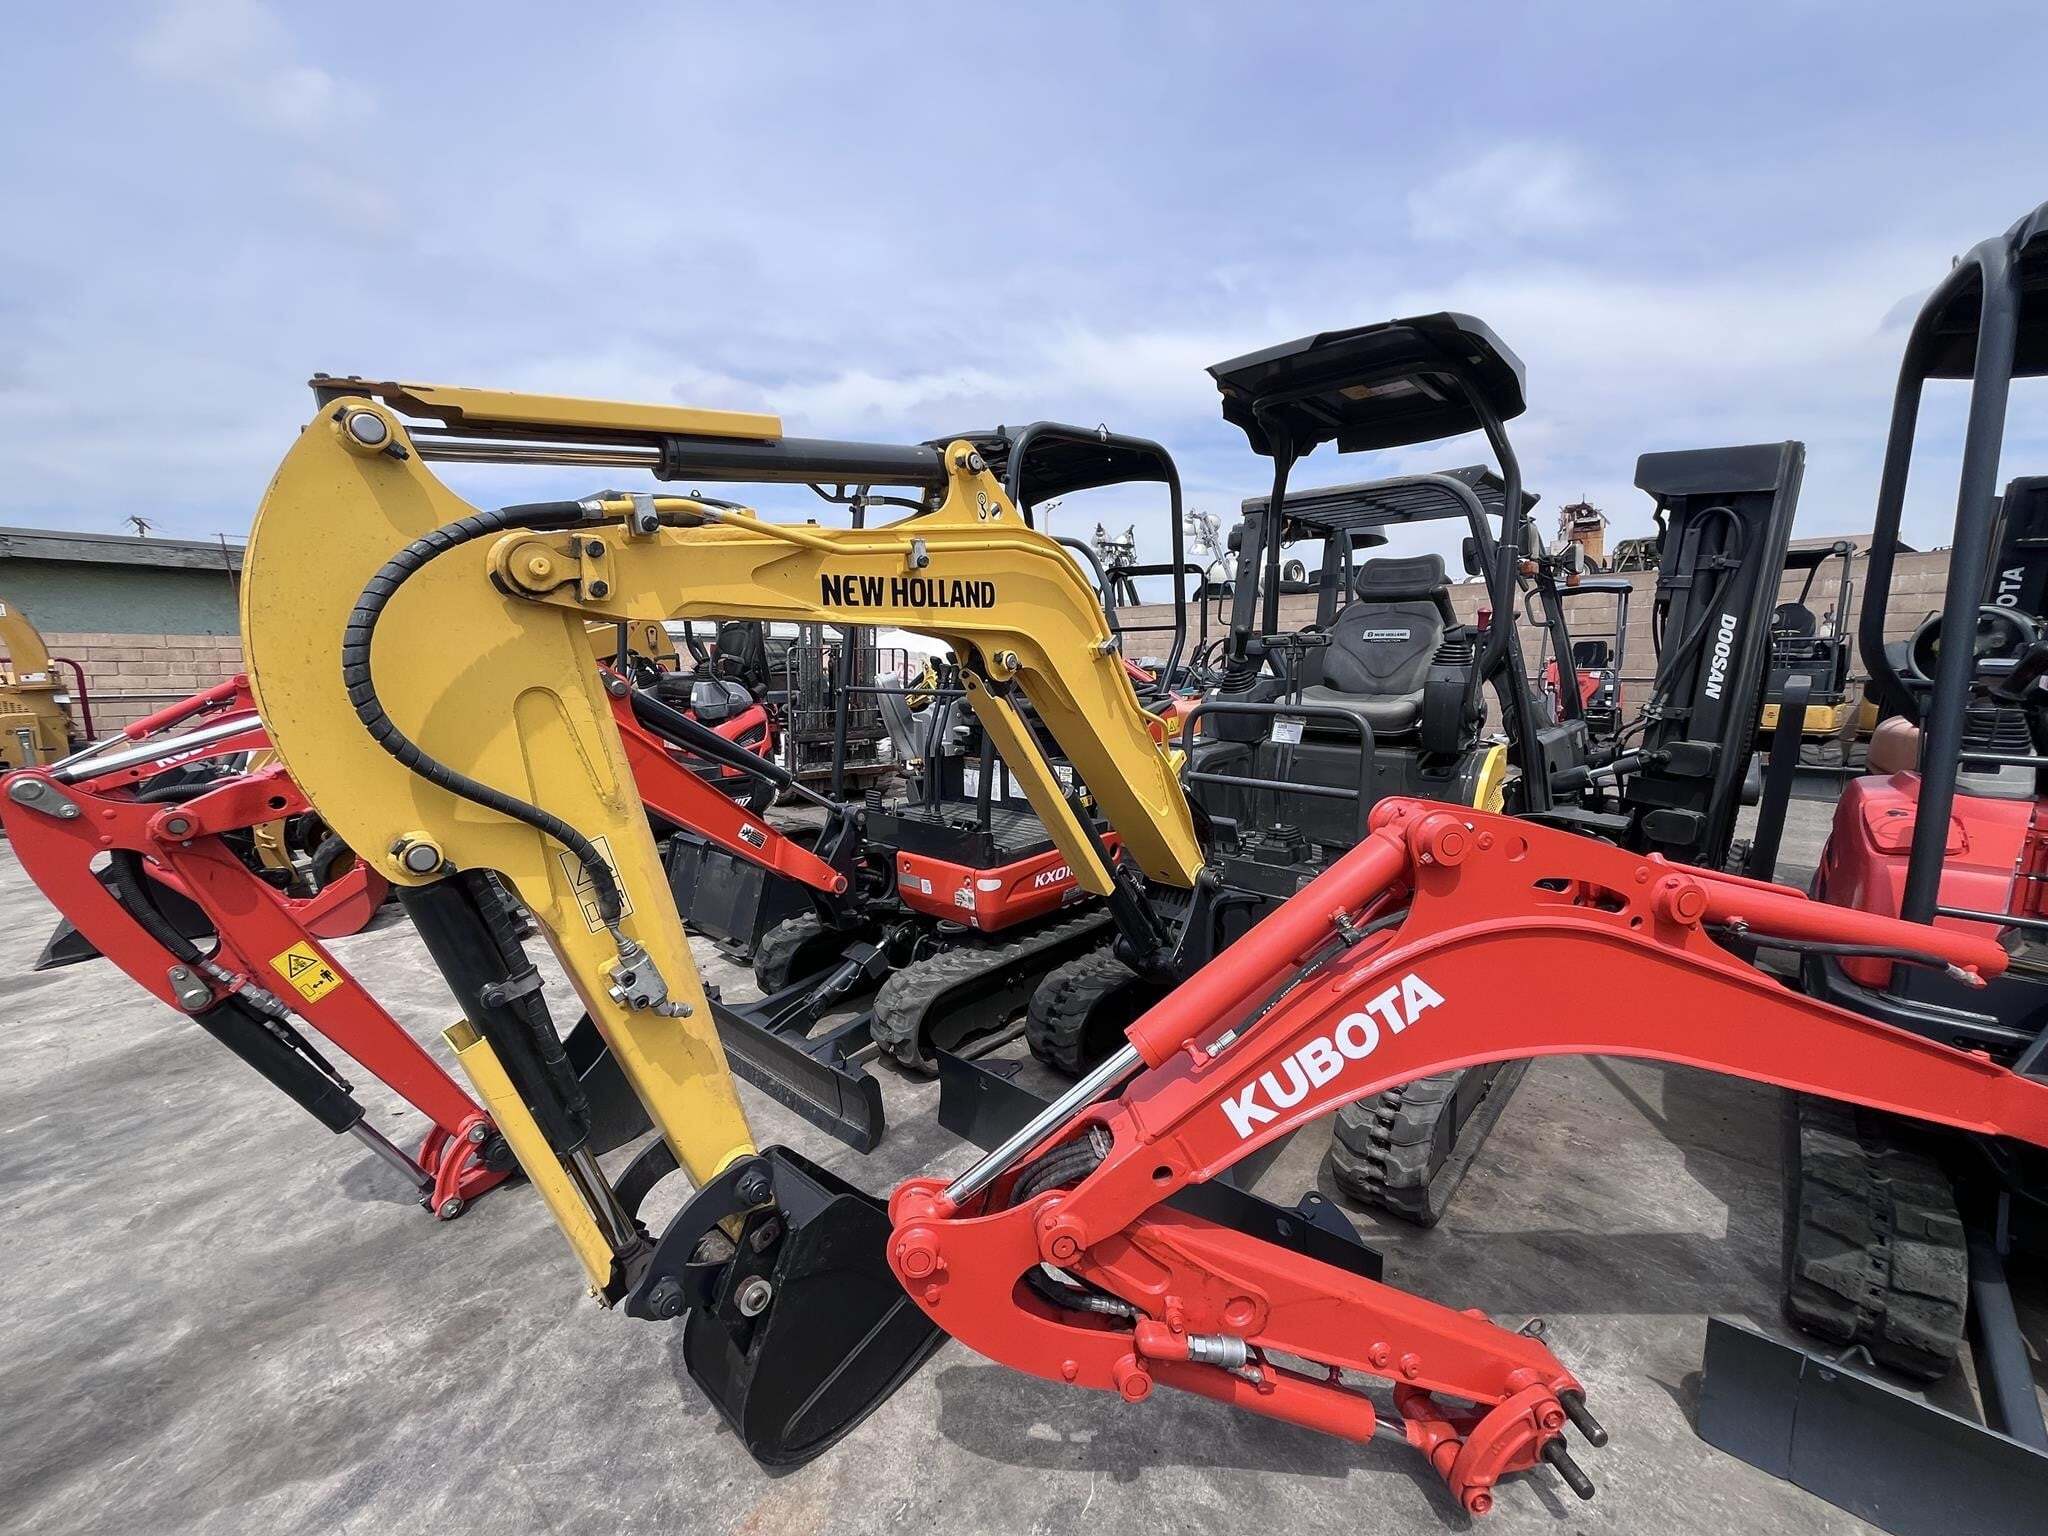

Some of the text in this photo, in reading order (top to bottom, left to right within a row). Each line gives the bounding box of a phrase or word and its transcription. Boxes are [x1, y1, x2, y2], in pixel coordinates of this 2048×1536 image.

[821, 574, 996, 609] NEW HOLLAND
[1705, 613, 1738, 700] DOOSAN
[1034, 865, 1074, 888] KX01
[1220, 973, 1446, 1140] KUBOTA
